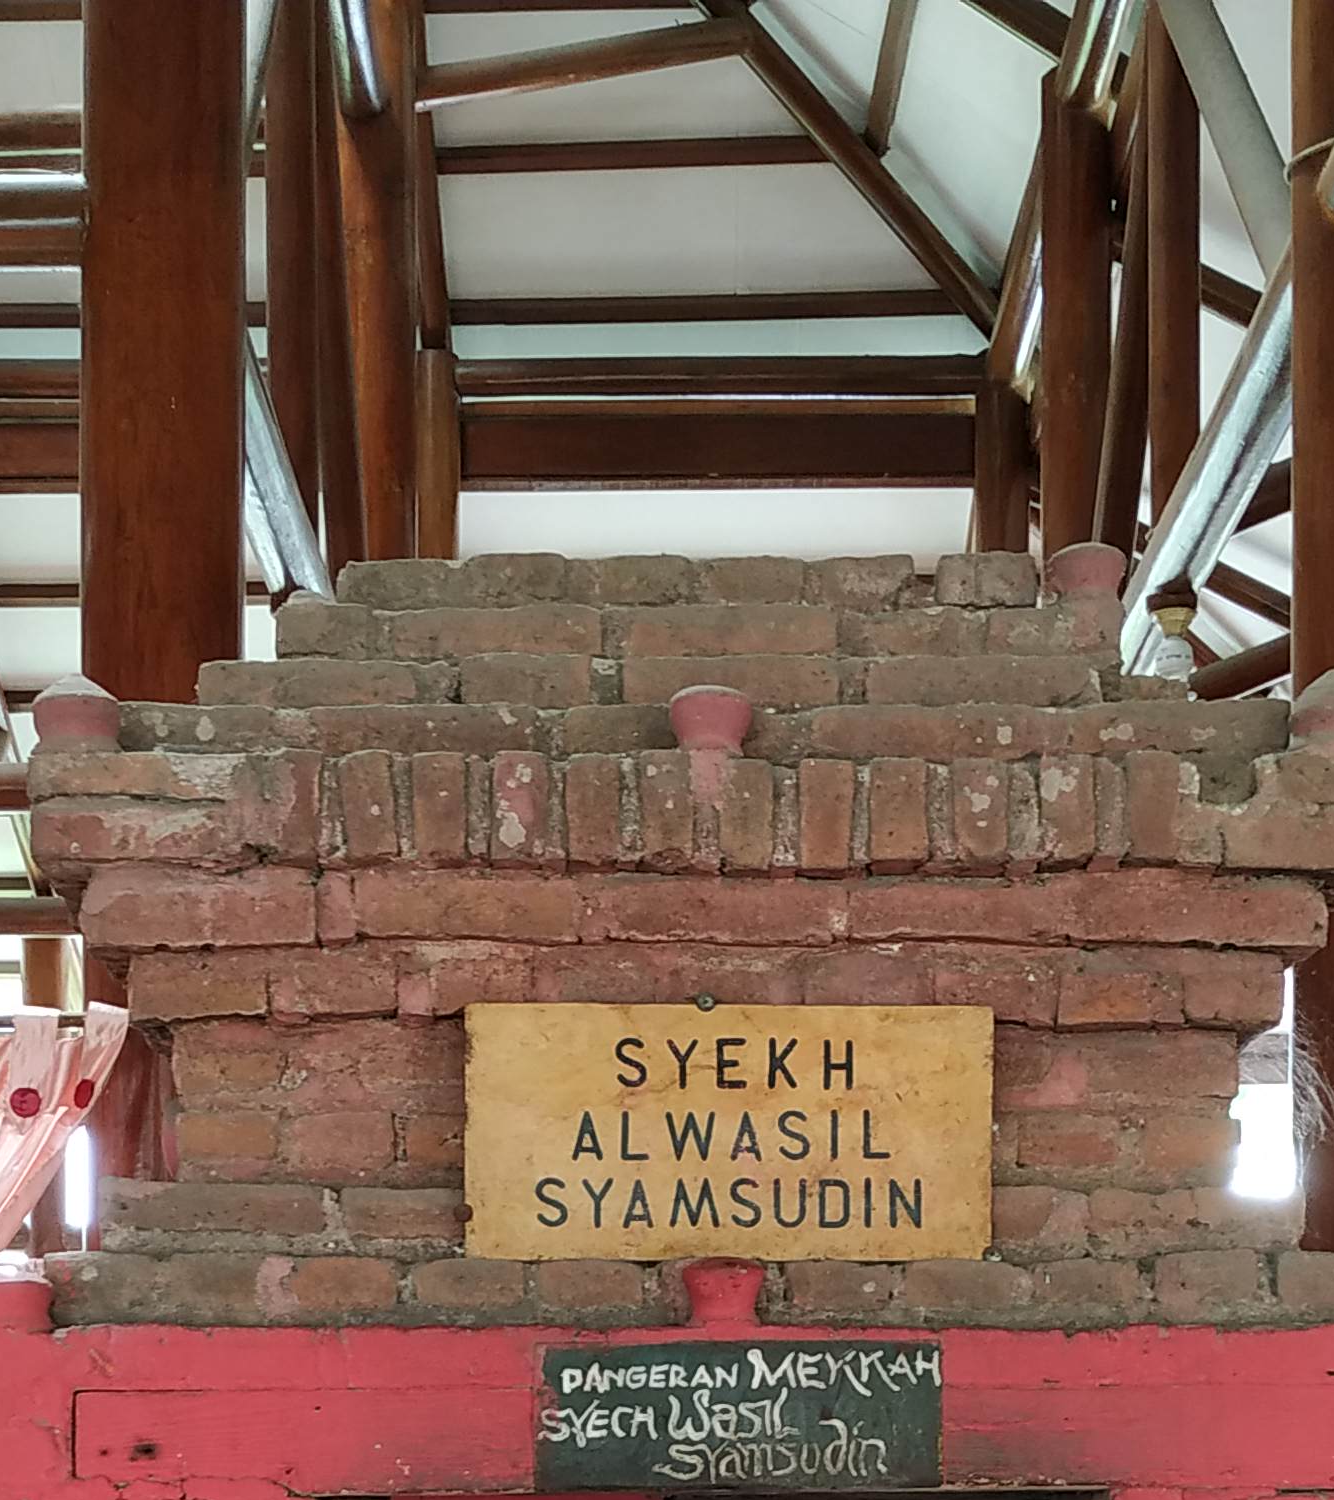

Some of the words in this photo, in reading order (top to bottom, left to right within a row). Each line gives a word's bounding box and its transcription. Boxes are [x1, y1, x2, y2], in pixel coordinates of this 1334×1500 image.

[614, 1037, 855, 1090] SYEKH
[571, 1109, 892, 1161] ALWASIL
[534, 1176, 923, 1229] SYAMSUDIN
[560, 1362, 739, 1394] PANGERAN
[747, 1348, 942, 1397] MEKKAH
[537, 1399, 659, 1448] SYECH
